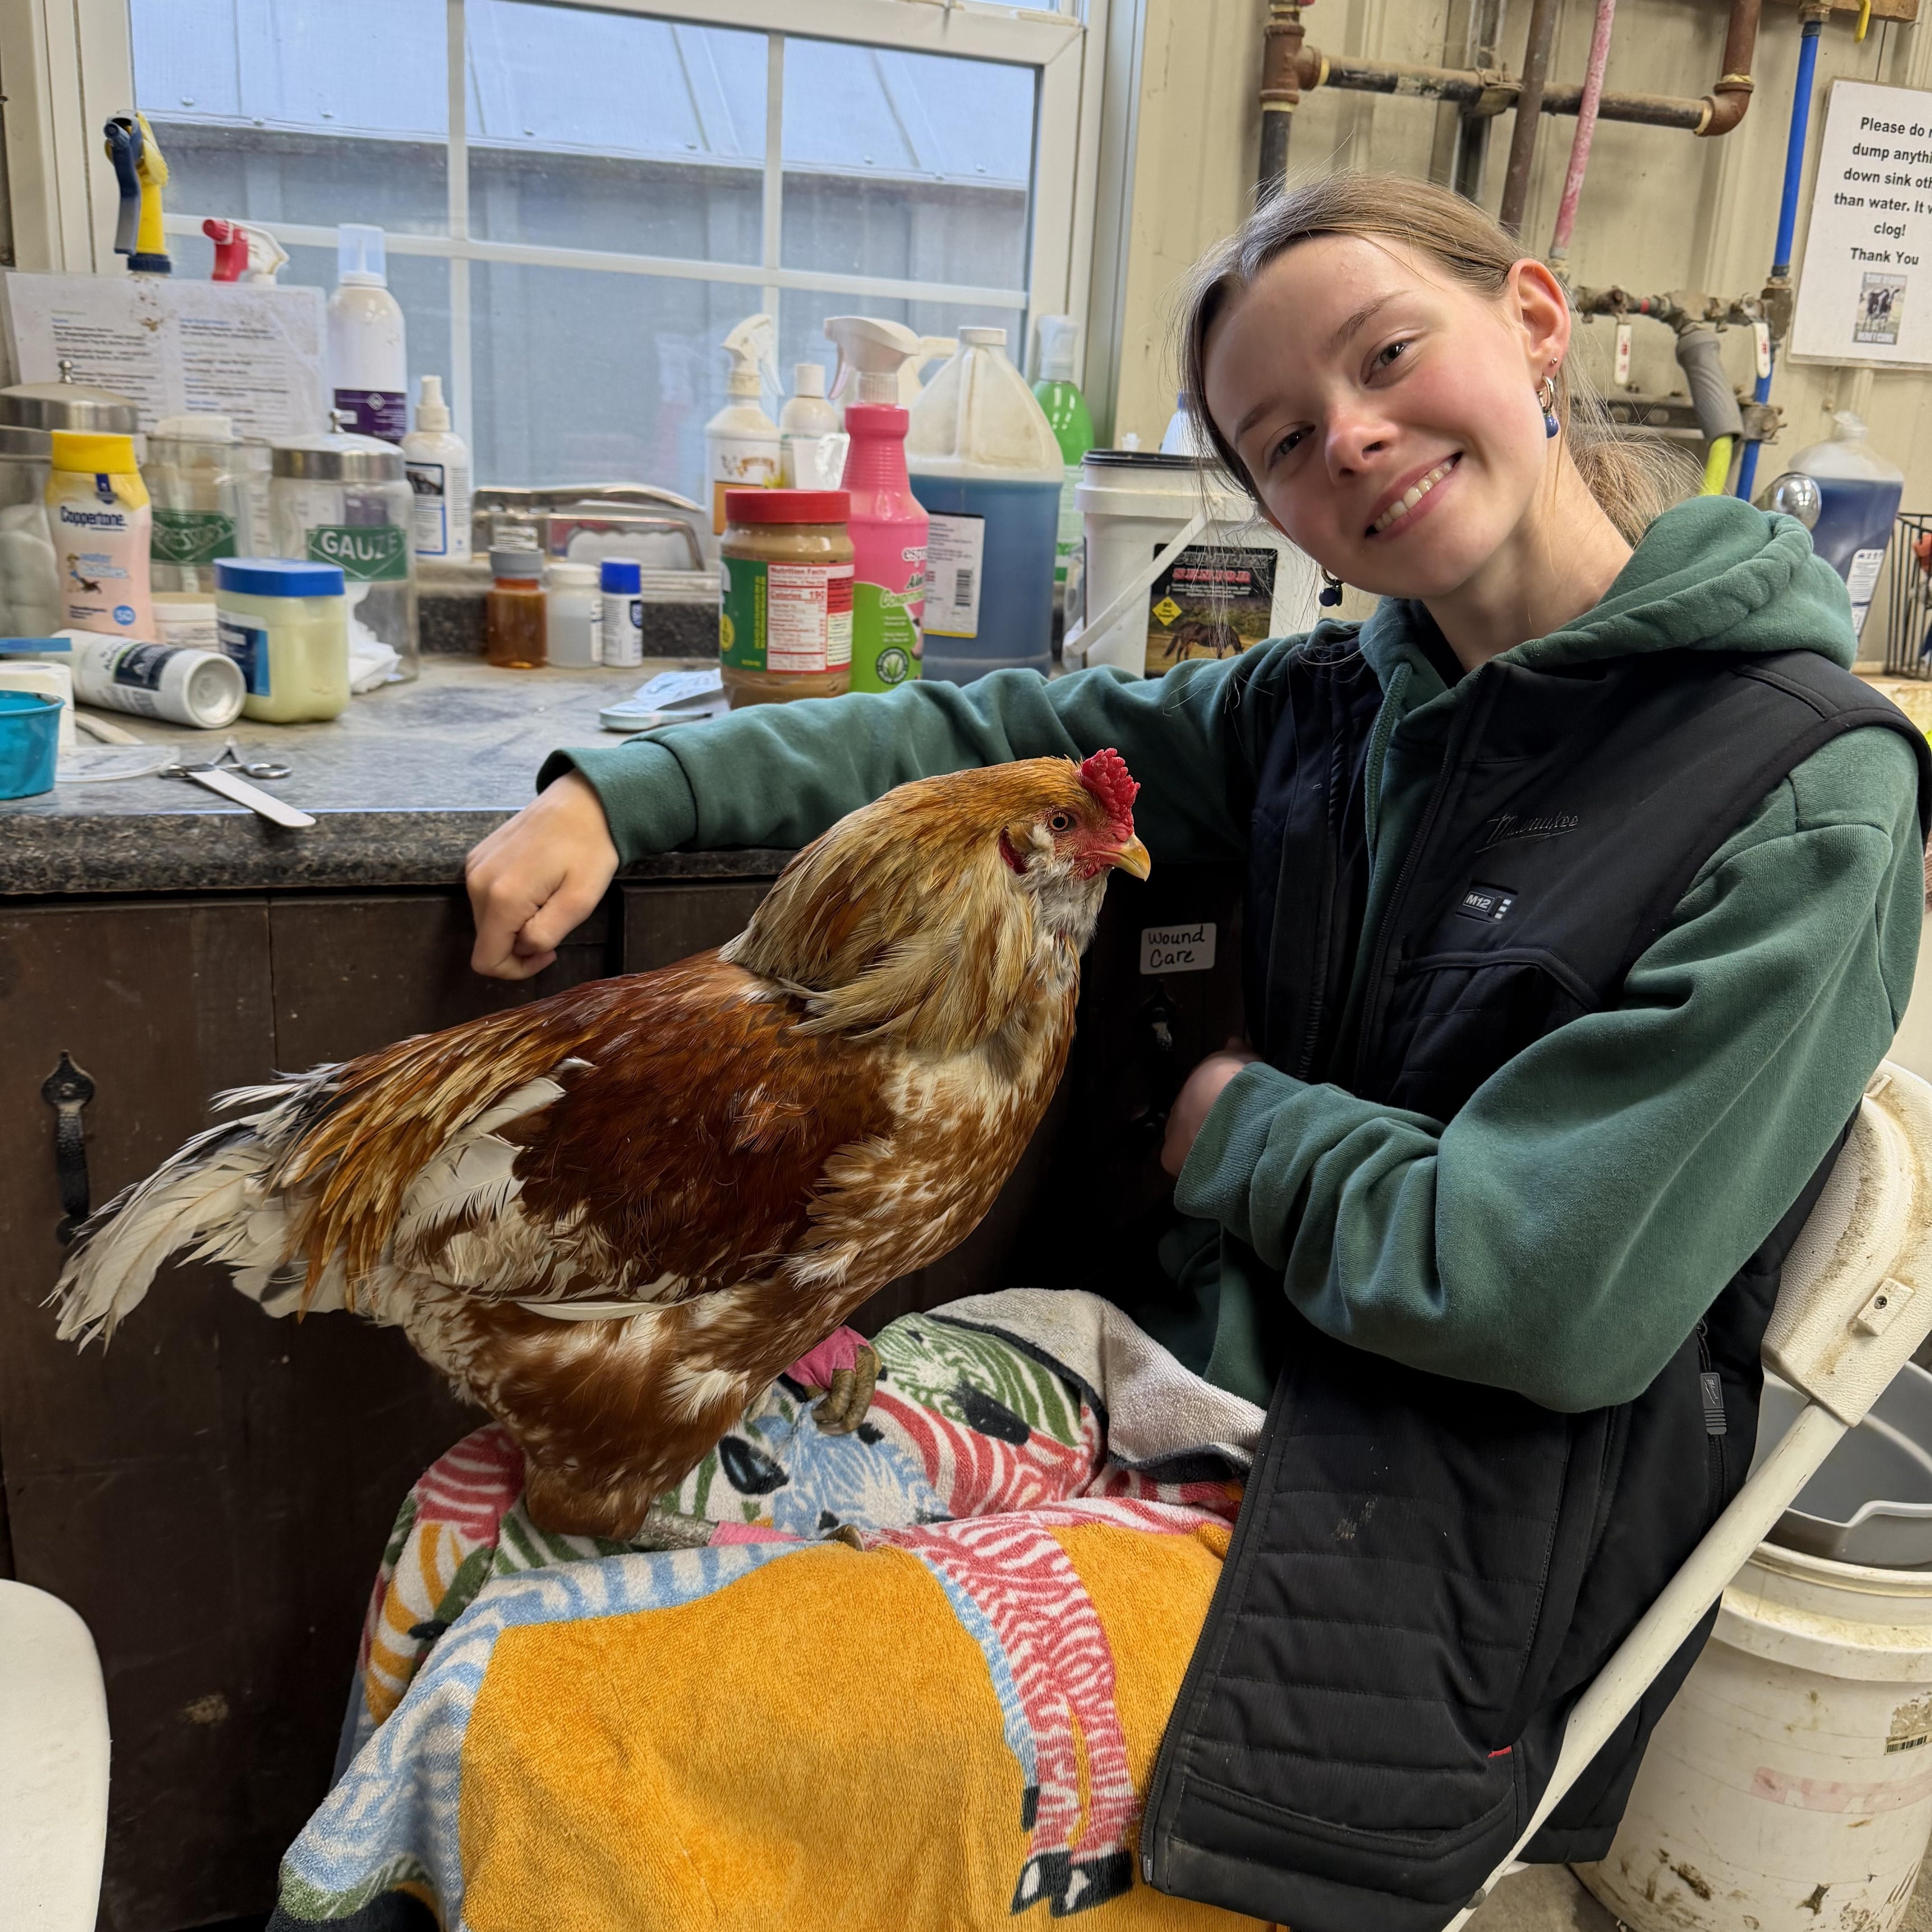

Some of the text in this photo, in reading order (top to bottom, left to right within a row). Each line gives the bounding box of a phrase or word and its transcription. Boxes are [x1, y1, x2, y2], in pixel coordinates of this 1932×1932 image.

[1860, 117, 1905, 134] Please
[1909, 123, 1925, 136] do
[1852, 143, 1889, 161] dump
[1844, 168, 1880, 183] down
[1884, 172, 1911, 186] sink
[1834, 193, 1864, 207] than
[1869, 198, 1909, 212] water.
[1914, 200, 1923, 213] It
[1874, 222, 1906, 239] clog!
[1850, 248, 1919, 265] Thank You
[61, 506, 127, 527] Coppertone
[321, 531, 398, 561] GAUZE
[1173, 568, 1251, 584] SENIOR
[1465, 894, 1492, 910] M12
[1150, 949, 1195, 968] Care
